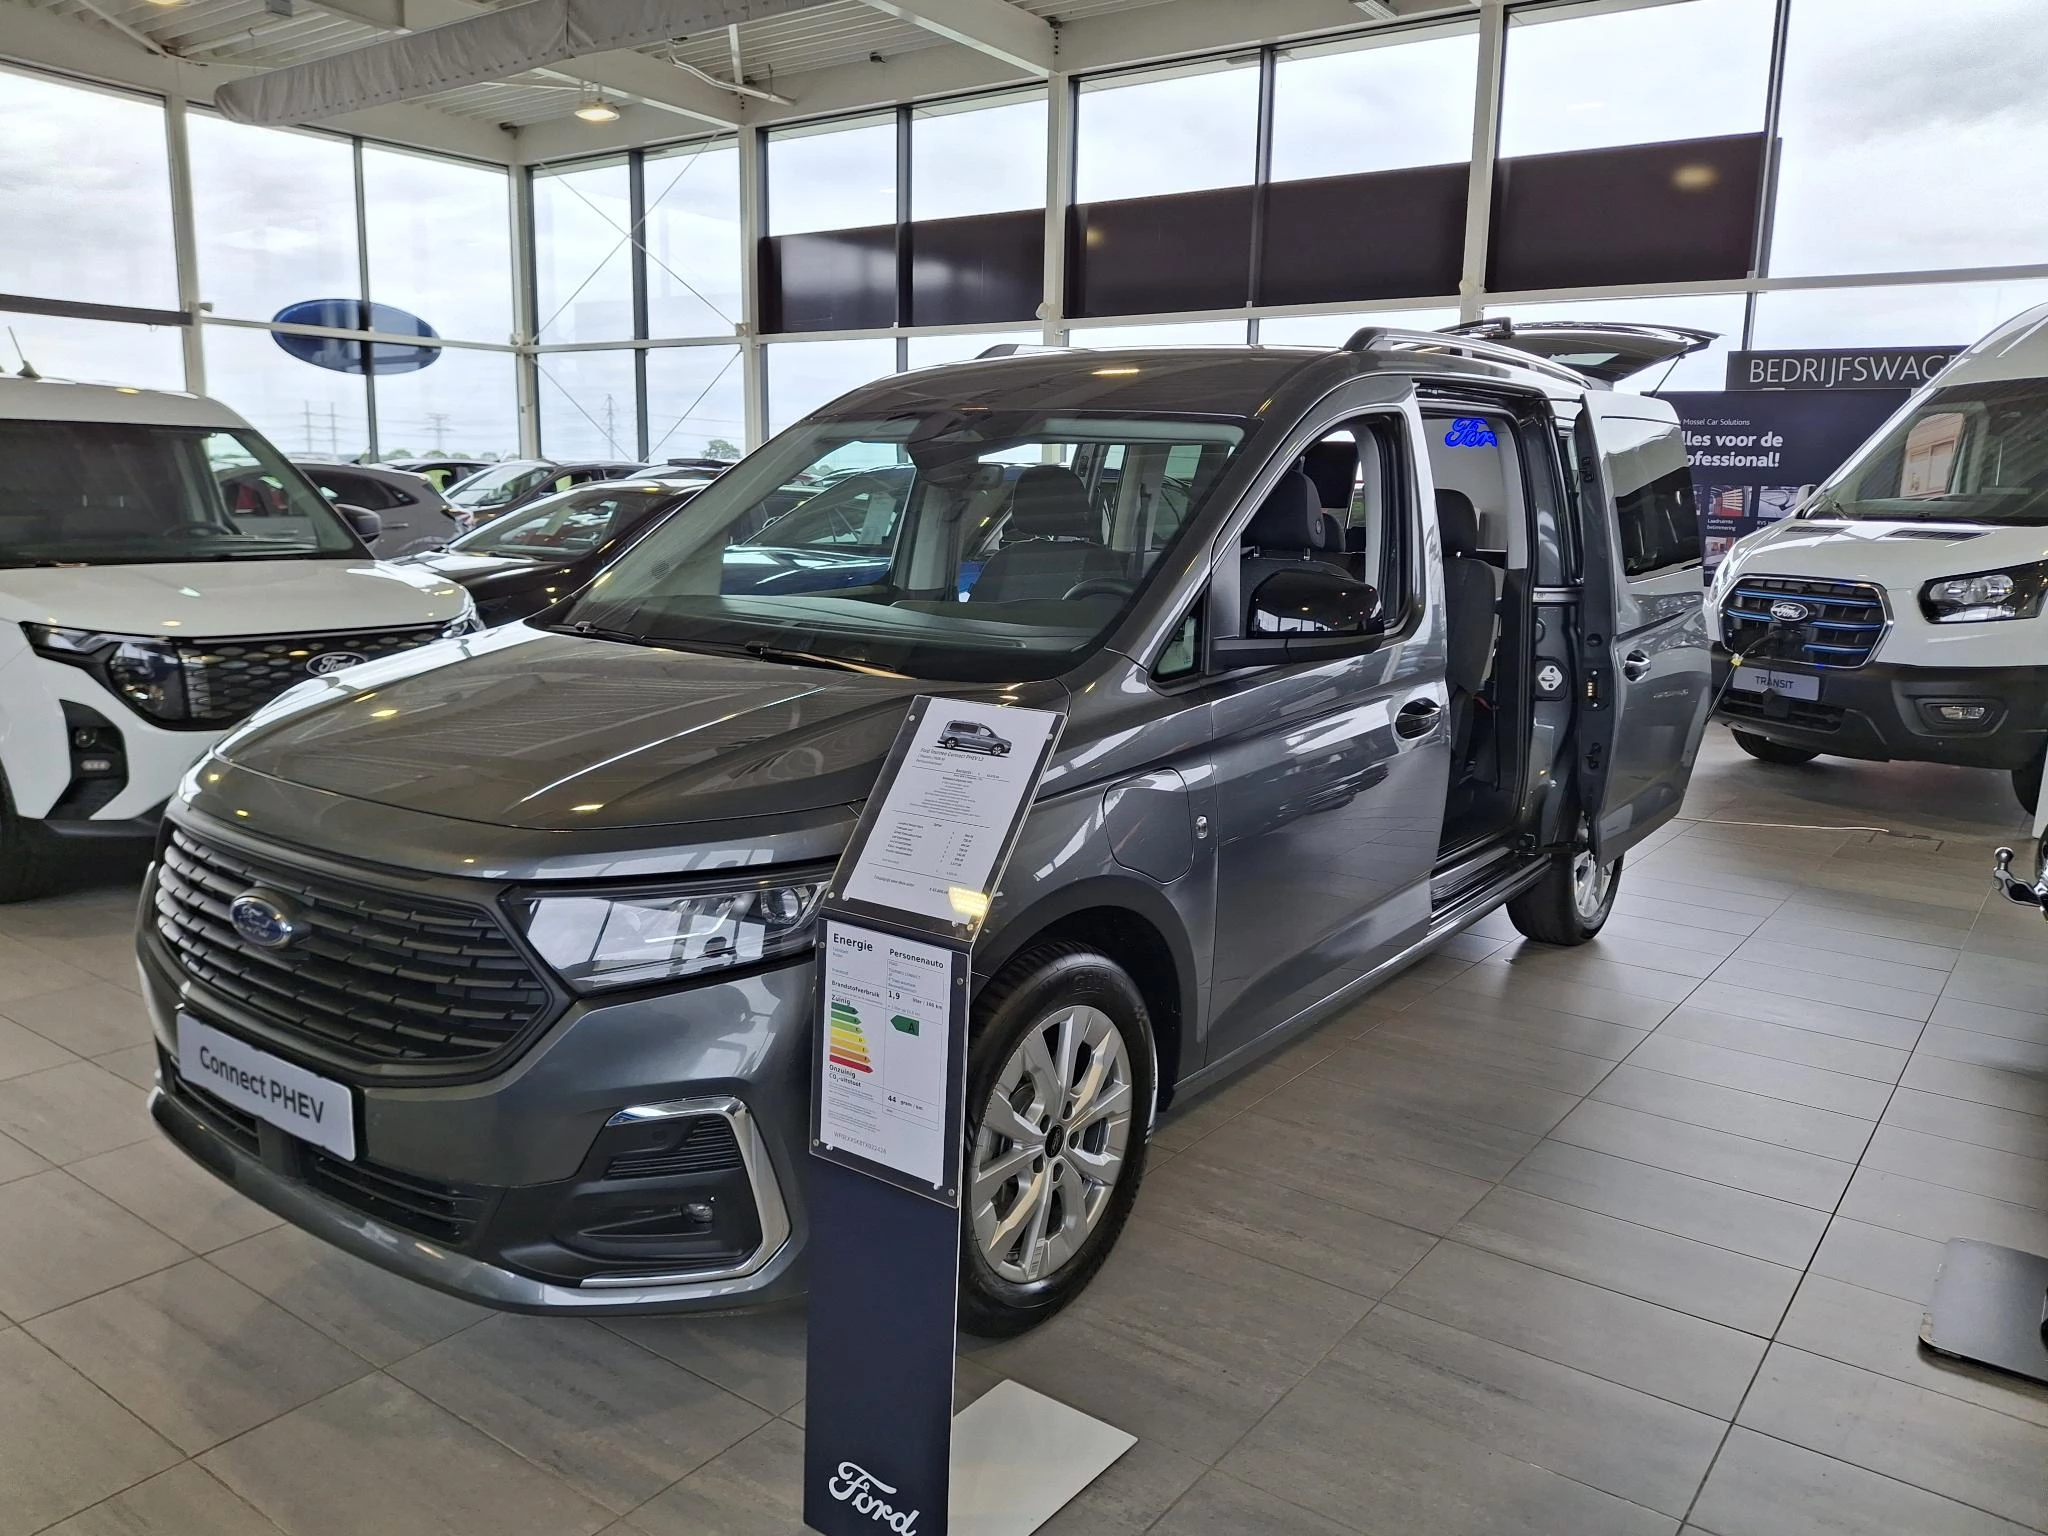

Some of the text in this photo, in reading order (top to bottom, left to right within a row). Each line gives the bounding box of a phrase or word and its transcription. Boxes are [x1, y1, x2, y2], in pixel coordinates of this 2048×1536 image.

[1681, 431, 1783, 447] lles voor de
[1687, 451, 1780, 468] ofessional!
[1772, 603, 1804, 619] Ford
[1755, 675, 1794, 688] TRANSIT
[833, 933, 873, 951] Energie
[889, 948, 944, 968] Personenauto
[831, 980, 880, 998] Brandstofverbruik
[888, 991, 900, 1000] 1,9
[831, 994, 850, 1006] Zuinig
[908, 1022, 915, 1033] A
[829, 1064, 856, 1079] Onzuinig
[200, 1045, 324, 1124] Connect PHEV
[888, 1095, 897, 1103] 44
[828, 1461, 920, 1536] Ford
